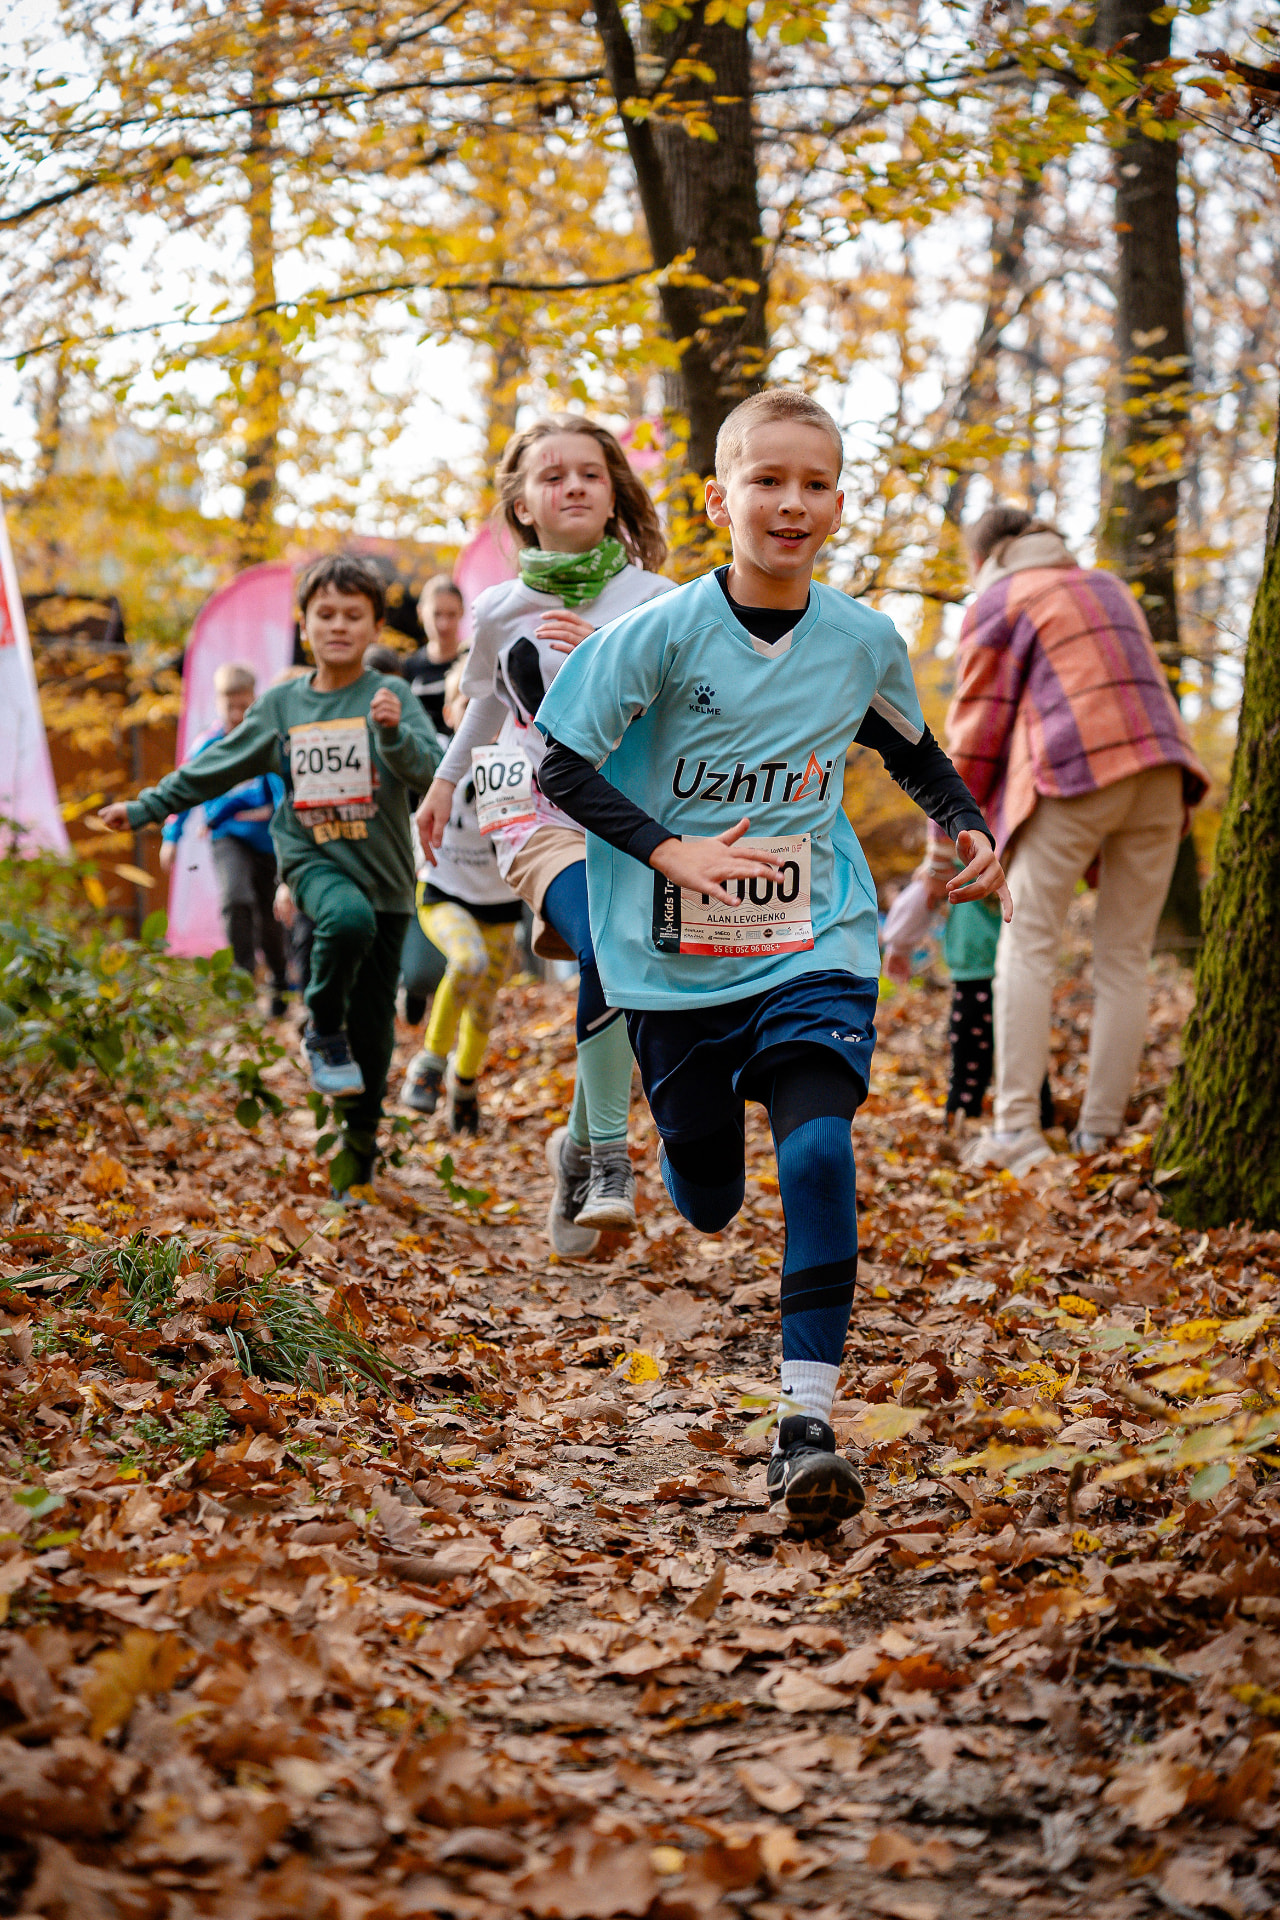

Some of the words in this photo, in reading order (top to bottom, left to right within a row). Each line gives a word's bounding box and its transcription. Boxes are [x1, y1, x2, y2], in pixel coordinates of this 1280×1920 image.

[688, 703, 721, 716] KELME
[296, 745, 361, 775] 2054
[701, 860, 800, 906] 00
[664, 897, 674, 922] Kids
[706, 914, 731, 924] ALAN
[734, 911, 786, 924] LEVCHENKO
[713, 945, 723, 953] 55
[724, 945, 734, 954] 33
[735, 945, 749, 954] 250
[750, 945, 760, 953] 96
[761, 943, 781, 952] +380
